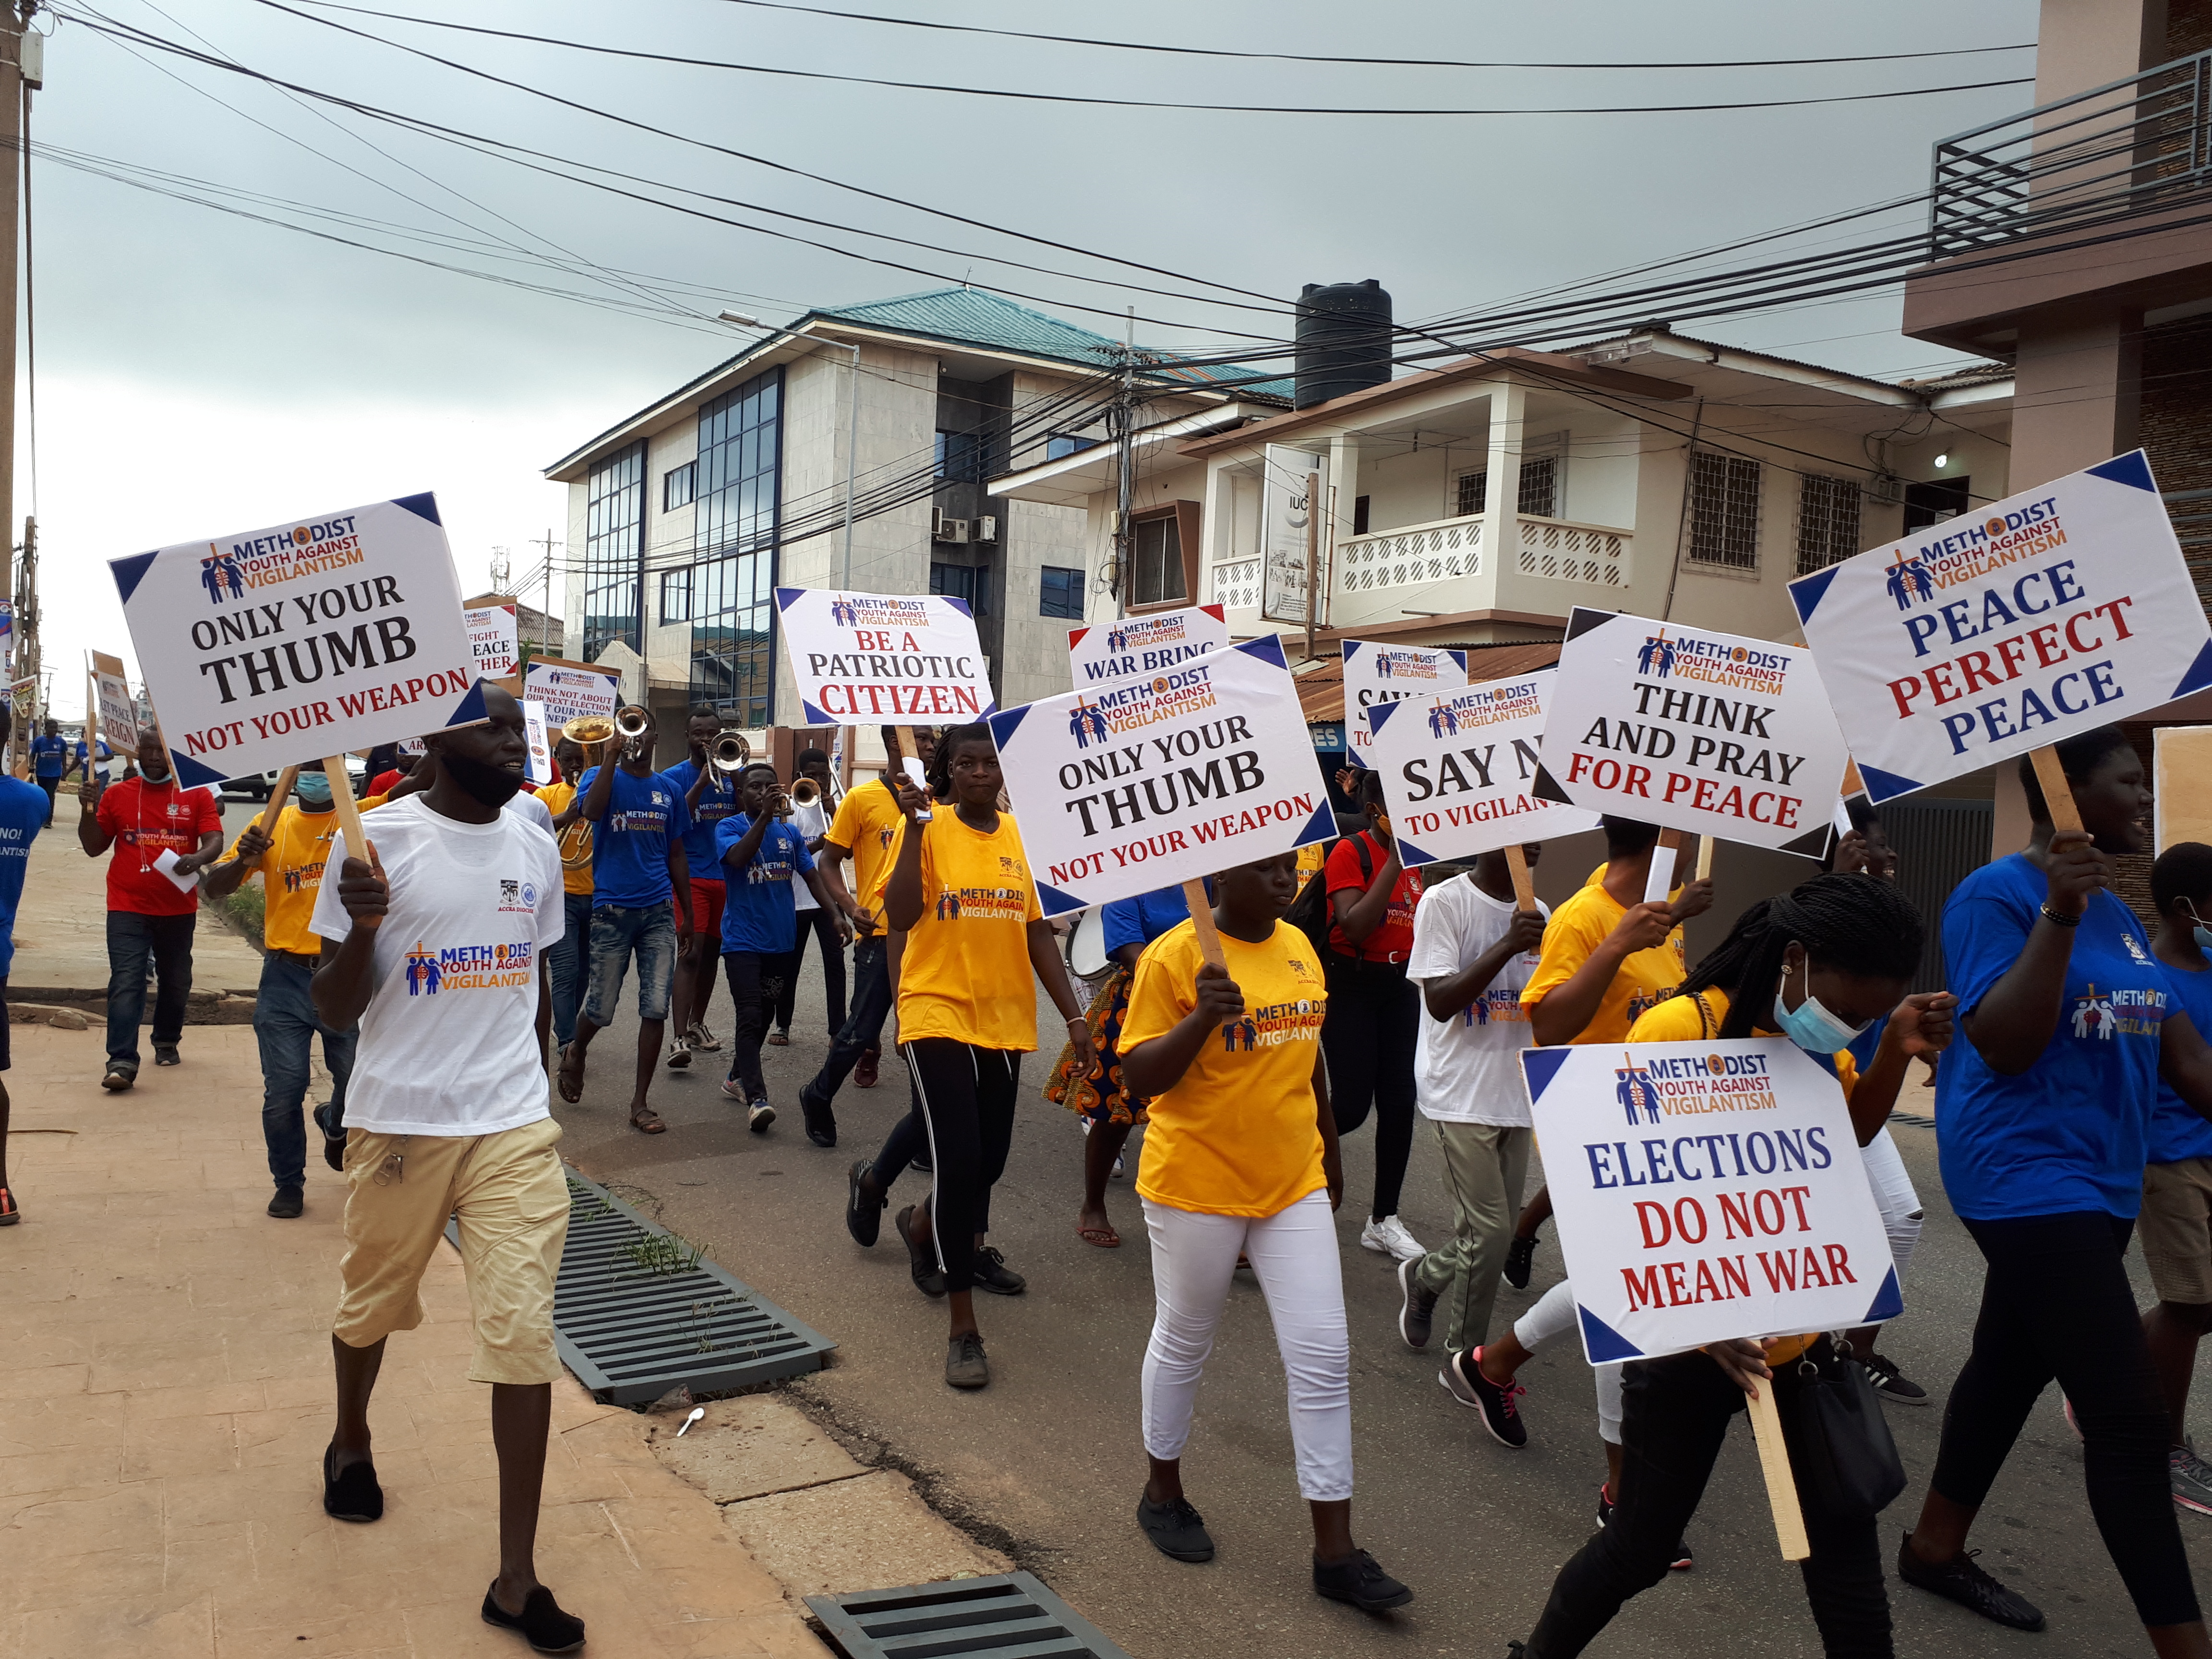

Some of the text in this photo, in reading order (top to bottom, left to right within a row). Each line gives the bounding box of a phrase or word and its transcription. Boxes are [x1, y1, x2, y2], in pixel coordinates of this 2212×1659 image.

[233, 516, 356, 561] METHODIST
[1920, 497, 2056, 563] METHODIST
[238, 535, 359, 574] YOUTH AGAINST
[1926, 517, 2060, 575] YOUTH AGAINST
[1931, 529, 2068, 590] VIGILANTISM
[244, 548, 365, 590] VIGILANTISM
[192, 575, 405, 651] ONLY YOUR
[853, 599, 925, 611] METHODIST
[855, 609, 927, 618] YOUTH AGAINST
[1902, 560, 2085, 658] PEACE
[857, 616, 929, 627] VIGILANTISM
[1124, 616, 1184, 634] METHODIST
[1127, 625, 1184, 640] YOUTH AGAINST
[473, 640, 510, 656] EACE
[854, 630, 921, 652] BE A
[1128, 631, 1186, 648] VIGILANTISM
[199, 616, 417, 705] THUMB
[807, 653, 975, 678] PATRIOTIC
[1083, 656, 1138, 680] WAR
[1390, 652, 1436, 664] METHODIST
[1676, 637, 1791, 671] METHODIST
[1887, 595, 2134, 720] PERFECT
[561, 672, 596, 681] METHODIST
[1392, 668, 1437, 679] VIGILANTISM
[1673, 664, 1784, 696] VIGILANTISM
[1675, 653, 1786, 684] YOUTH AGAINST
[528, 685, 613, 704] THINK NOT ABOUT
[561, 680, 594, 688] VIGILANTISM
[1099, 665, 1209, 709] METHODIST
[1452, 683, 1537, 709] METHODIST
[100, 697, 131, 722] LET PEACE
[183, 667, 469, 757] NOT YOUR WEAPON
[547, 697, 569, 706] NEXT
[571, 700, 611, 712] ELECTION
[554, 706, 576, 716] OUR
[819, 685, 980, 715] CITIZEN
[1104, 682, 1213, 721] YOUTH AGAINST
[1108, 693, 1217, 734] VIGILANTISM
[1455, 696, 1539, 719] YOUTH AGAINST
[1634, 682, 1775, 739] THINK
[1940, 660, 2124, 756] PEACE
[105, 715, 135, 745] REIGN
[1458, 705, 1541, 730] VIGILANTISM
[1058, 715, 1253, 791] ONLY YOUR
[1581, 716, 1805, 787] AND PRAY
[1403, 745, 1496, 802] SAY
[1066, 750, 1265, 838] THUMB
[1566, 752, 1803, 830] FOR PEACE
[1405, 793, 1561, 836] TO VIGILAN
[0, 828, 23, 840] NO!
[137, 839, 189, 847] VIGILANTISM
[1048, 792, 1314, 886] NOT YOUR WEAPON
[960, 898, 993, 908] YOUTH
[1387, 908, 1407, 918] YOUTH
[440, 956, 532, 974] YOUTH AGAINST
[441, 942, 532, 963] METHODIST
[1257, 1017, 1297, 1033] YOUTH
[1648, 1054, 1767, 1079] METHODIST
[1656, 1076, 1770, 1096] YOUTH AGAINST
[1659, 1092, 1778, 1116] VIGILANTISM
[1583, 1127, 1832, 1189] ELECTIONS
[1633, 1186, 1812, 1250] DO NOT
[1621, 1243, 1858, 1313] MEAN WAR
